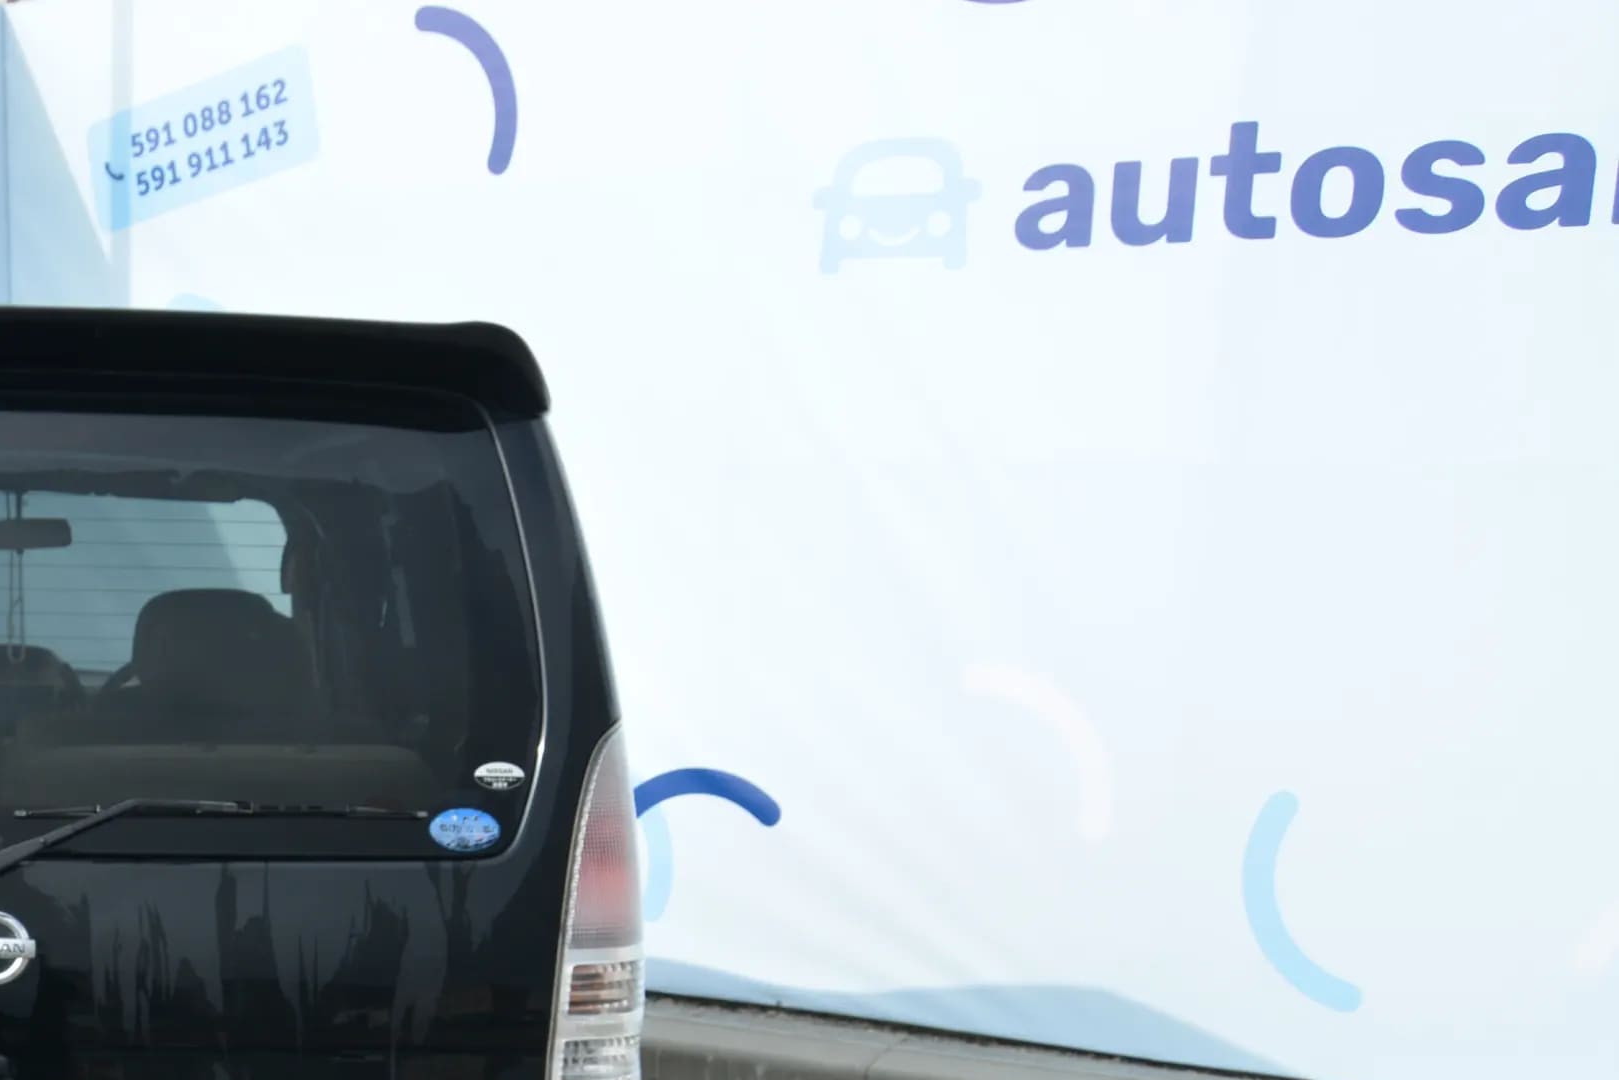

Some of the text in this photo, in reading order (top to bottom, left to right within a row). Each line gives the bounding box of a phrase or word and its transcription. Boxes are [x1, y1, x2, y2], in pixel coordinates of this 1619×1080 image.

[130, 77, 288, 158] 591 088 162
[135, 119, 289, 197] 591 911 143
[1014, 120, 1619, 251] autosa
